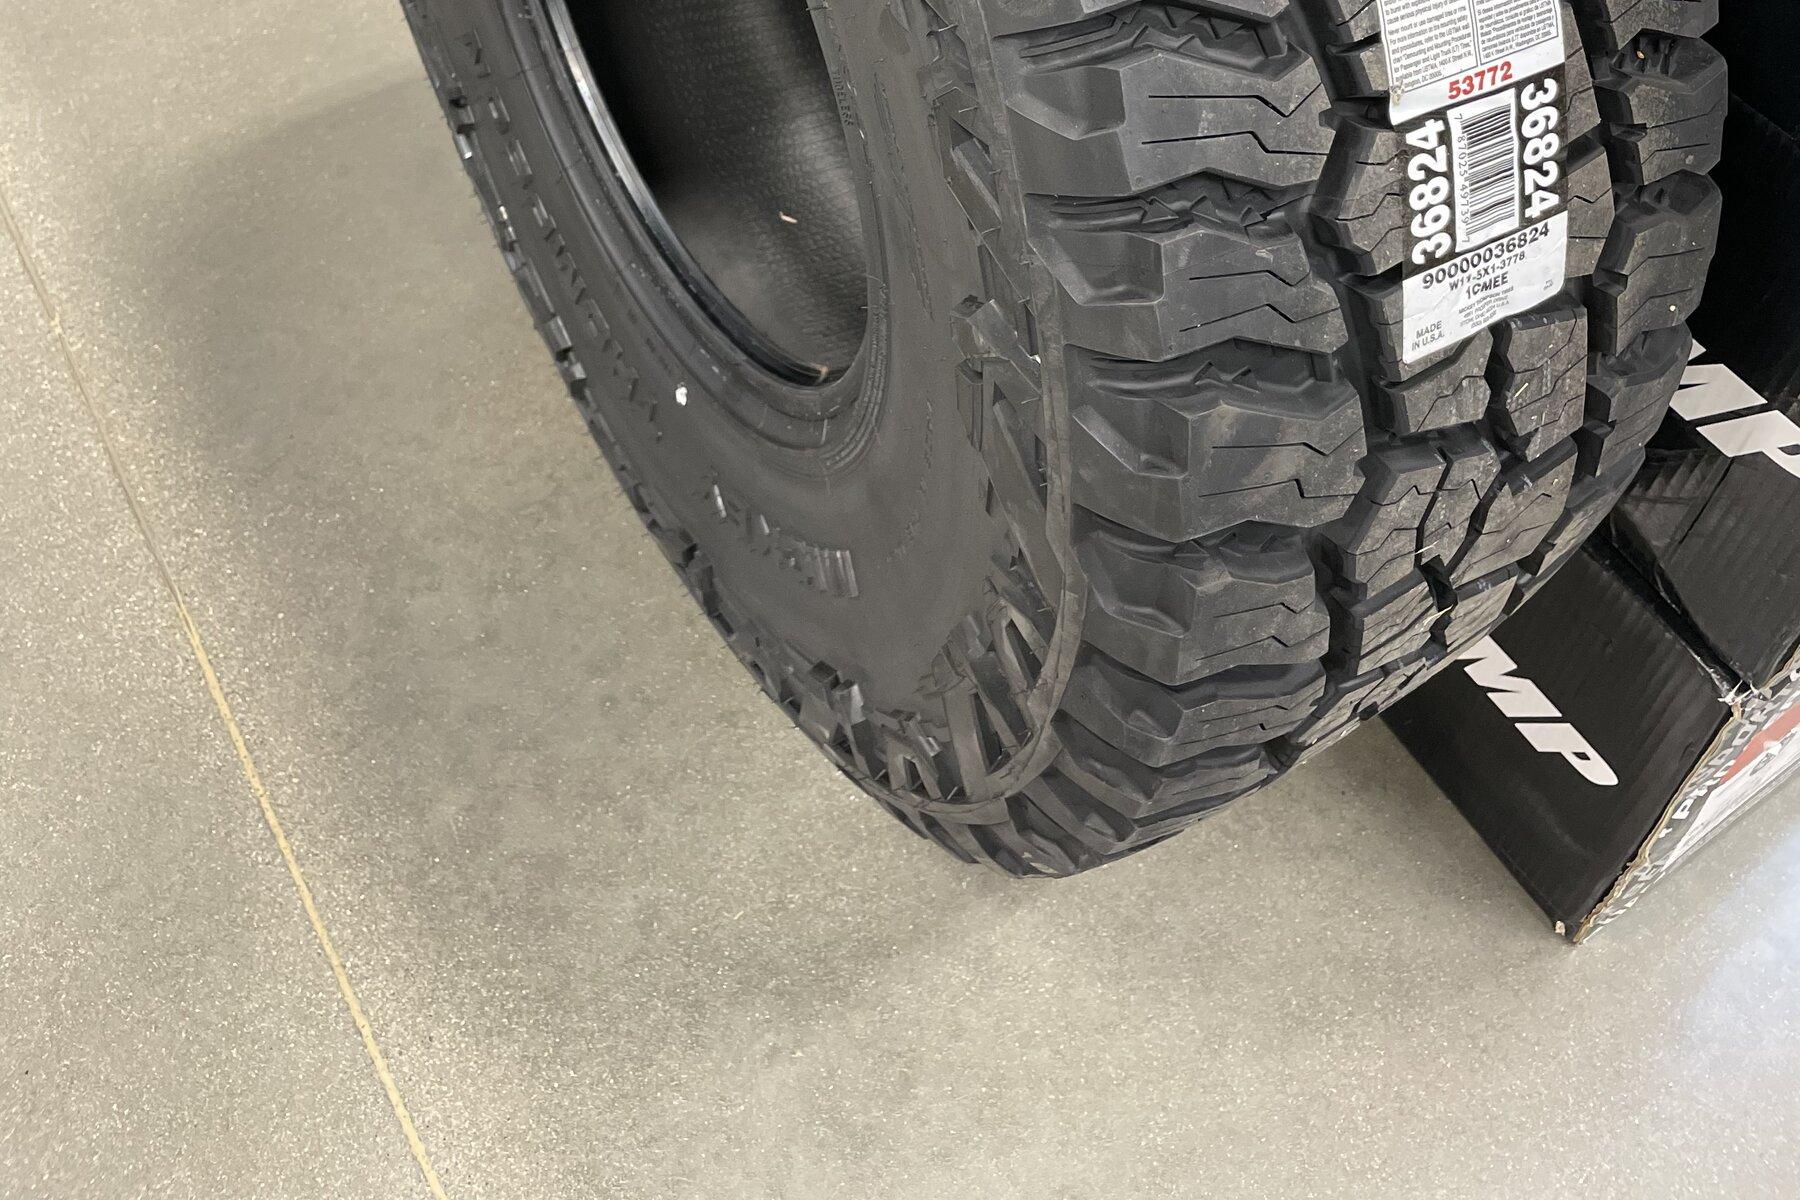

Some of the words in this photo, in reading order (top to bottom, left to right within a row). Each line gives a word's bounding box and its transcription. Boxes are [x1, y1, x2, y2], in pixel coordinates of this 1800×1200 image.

[1448, 61, 1513, 100] 53772
[1519, 77, 1561, 220] 36824
[1404, 117, 1453, 267] 36824
[1422, 221, 1550, 290] 90000036824
[1411, 340, 1421, 352] IN
[1421, 331, 1446, 347] U.S.A.
[1415, 320, 1443, 340] MADE
